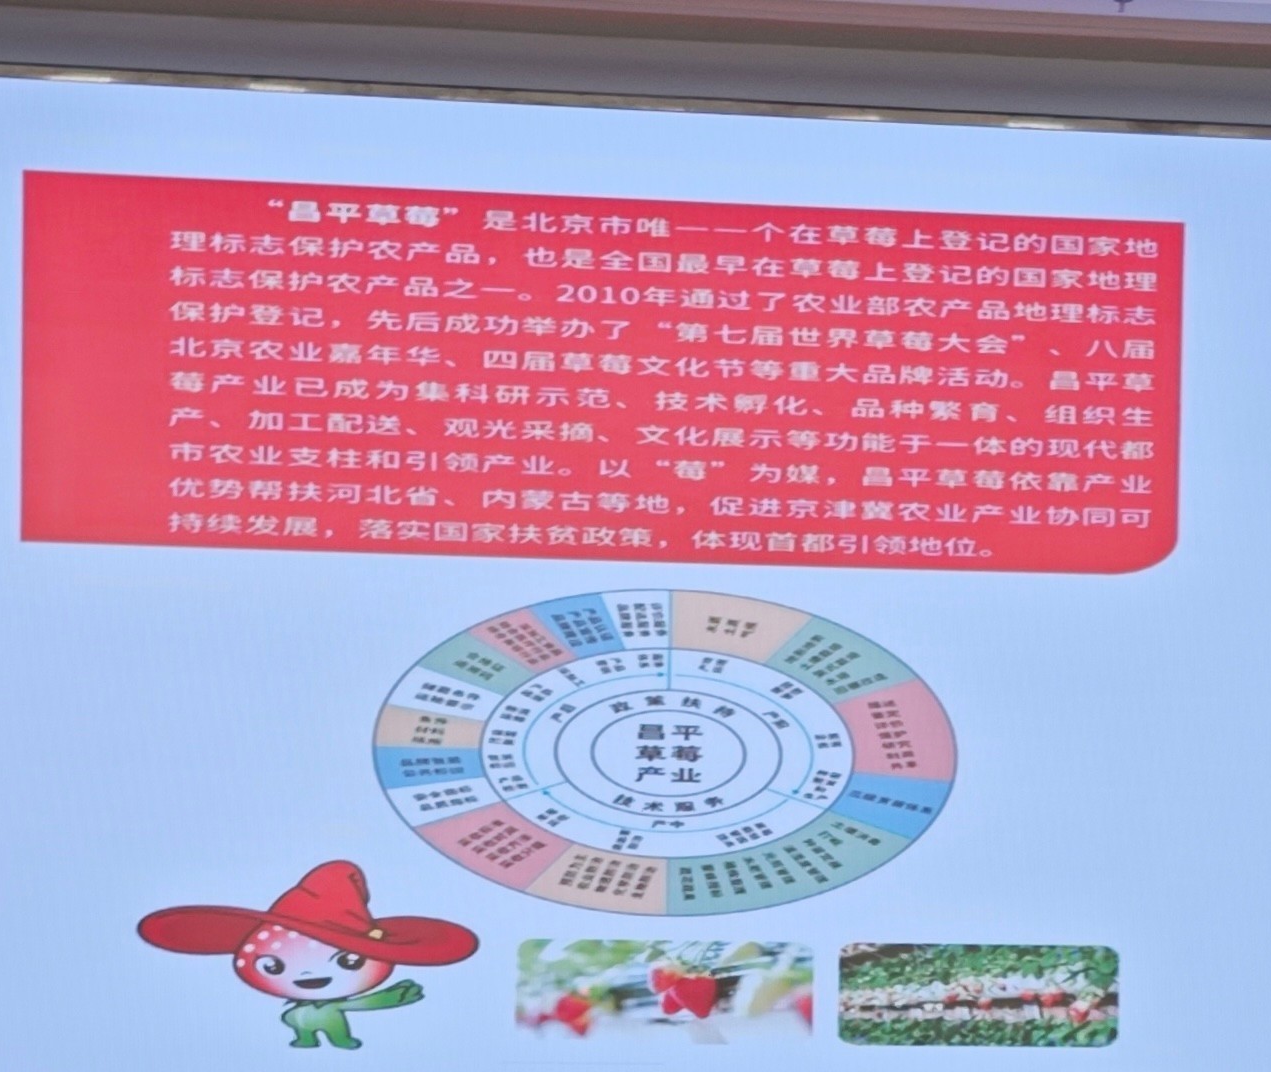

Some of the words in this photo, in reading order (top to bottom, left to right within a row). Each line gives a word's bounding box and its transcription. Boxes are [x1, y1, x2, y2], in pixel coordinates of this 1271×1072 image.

[637, 723, 703, 741] 昌平
[635, 745, 703, 762] 草莓
[635, 766, 702, 783] 产业
